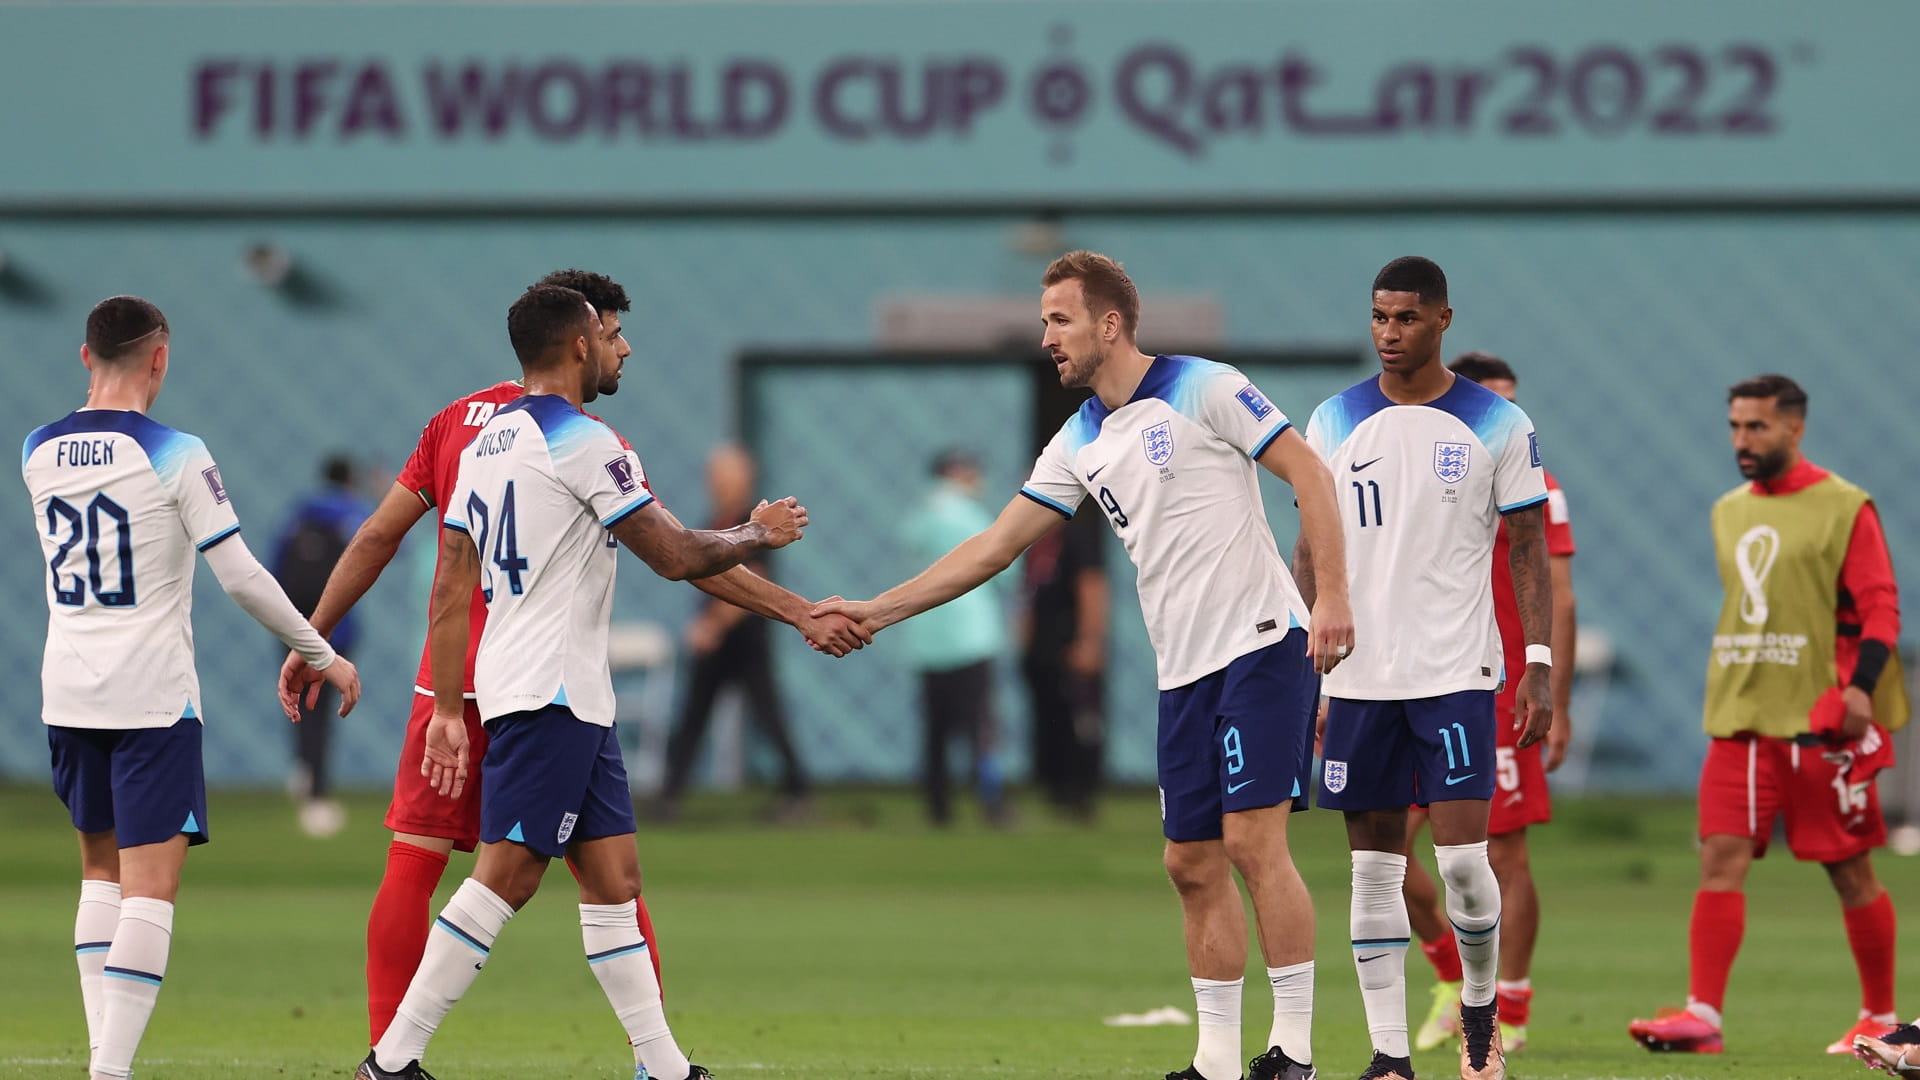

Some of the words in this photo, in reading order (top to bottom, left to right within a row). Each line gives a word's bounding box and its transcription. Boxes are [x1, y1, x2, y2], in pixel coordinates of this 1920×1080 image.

[189, 58, 407, 141] FIFA
[421, 58, 793, 142] WORLD
[812, 57, 1008, 142] CUP
[463, 401, 509, 427] TA
[57, 440, 115, 467] FODEN
[476, 427, 520, 458] WILSON
[1098, 486, 1129, 528] 9
[1352, 480, 1383, 527] 11
[46, 491, 137, 608] 20
[1223, 726, 1244, 775] 9
[1438, 722, 1471, 770] 11
